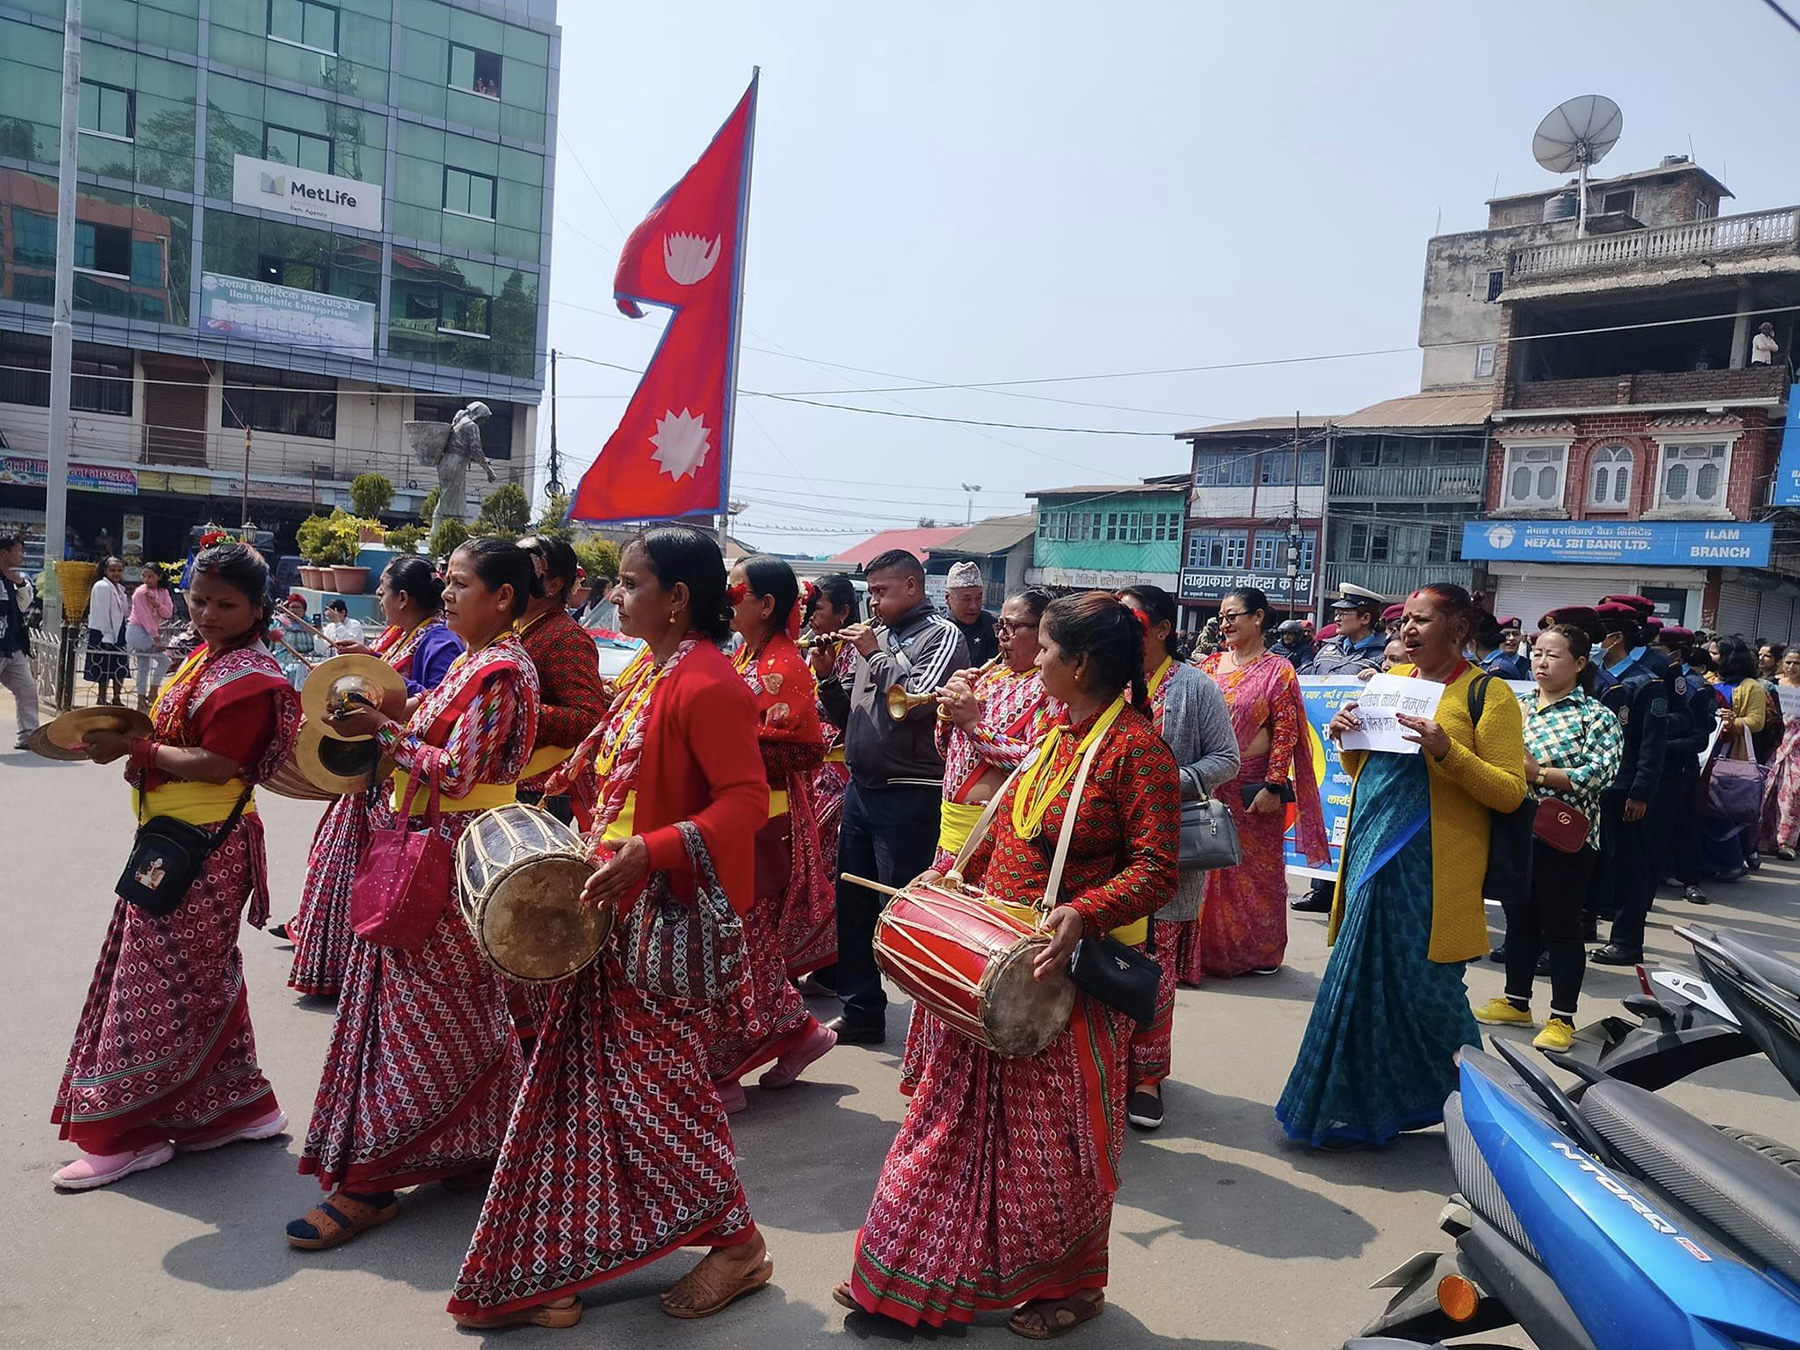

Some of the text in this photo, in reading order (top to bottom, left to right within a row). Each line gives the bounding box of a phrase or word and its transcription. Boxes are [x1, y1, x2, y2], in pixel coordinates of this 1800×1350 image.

[291, 181, 357, 208] MetLife
[305, 208, 327, 218] Agency
[218, 277, 248, 290] इलाम
[229, 289, 349, 318] Ilam Holistic Enterprises
[1525, 525, 1549, 536] नेपाल
[1705, 529, 1740, 540] ILAM
[1524, 538, 1651, 550] NEPAL SBI BANK LTD.
[1690, 546, 1750, 558] BRANCH
[1184, 574, 1233, 588] ताम्राकार
[1235, 574, 1277, 592] स्वीट्स
[1551, 1142, 1713, 1262] NTORQ 125
